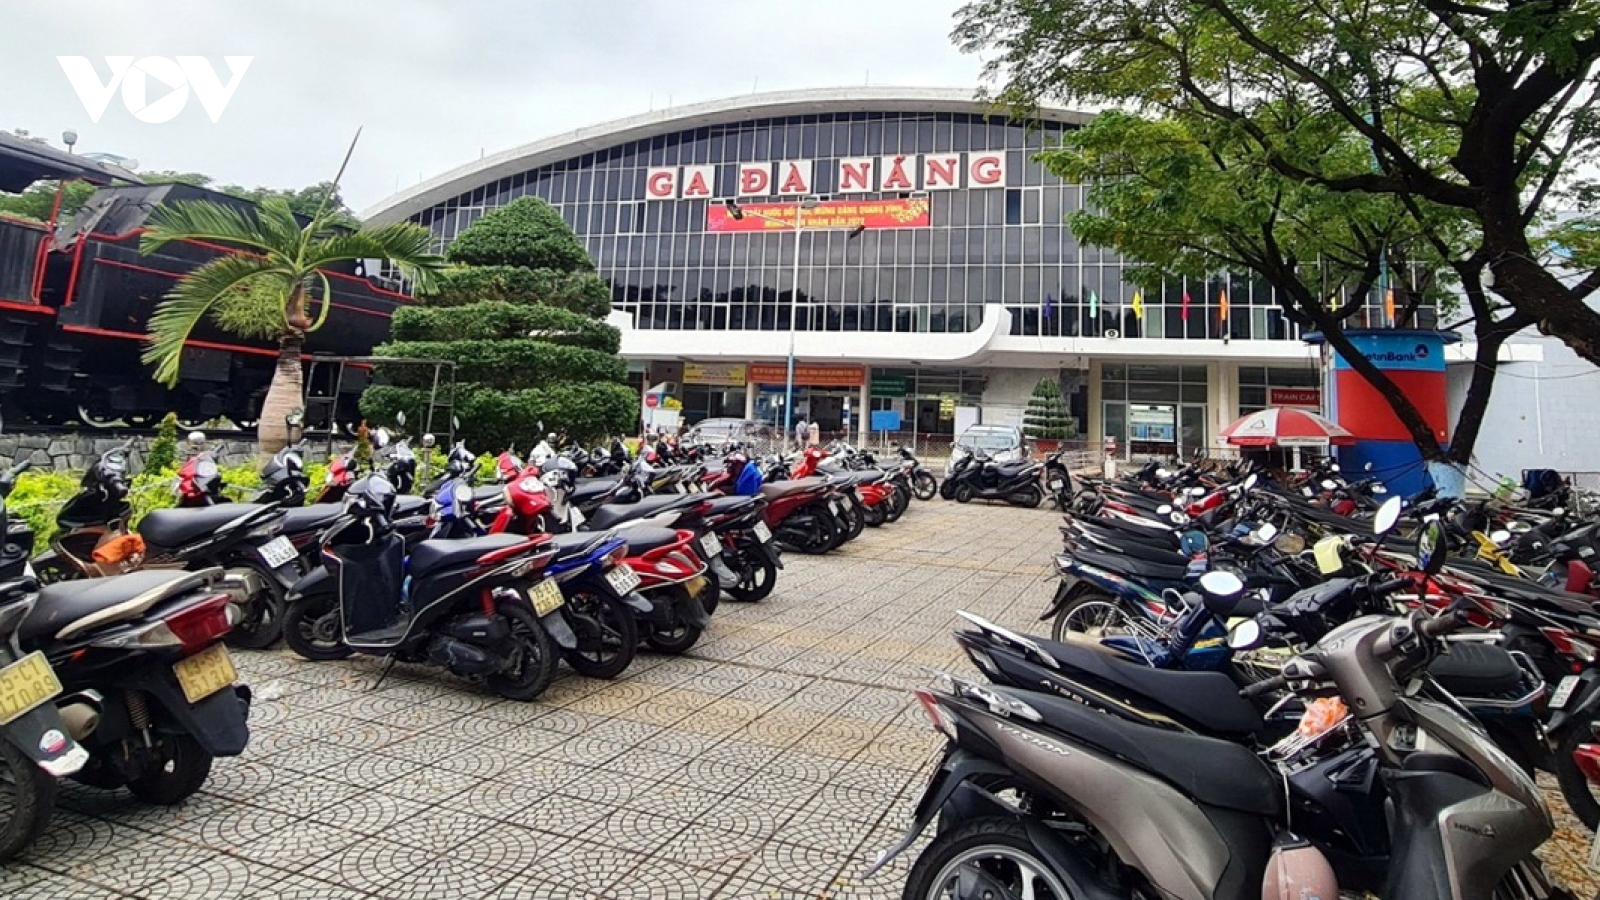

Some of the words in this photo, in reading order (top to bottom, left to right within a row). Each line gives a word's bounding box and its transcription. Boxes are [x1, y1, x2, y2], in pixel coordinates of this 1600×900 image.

[648, 171, 709, 197] GA
[741, 162, 807, 193] ĐÀ
[995, 721, 1070, 755] VISION
